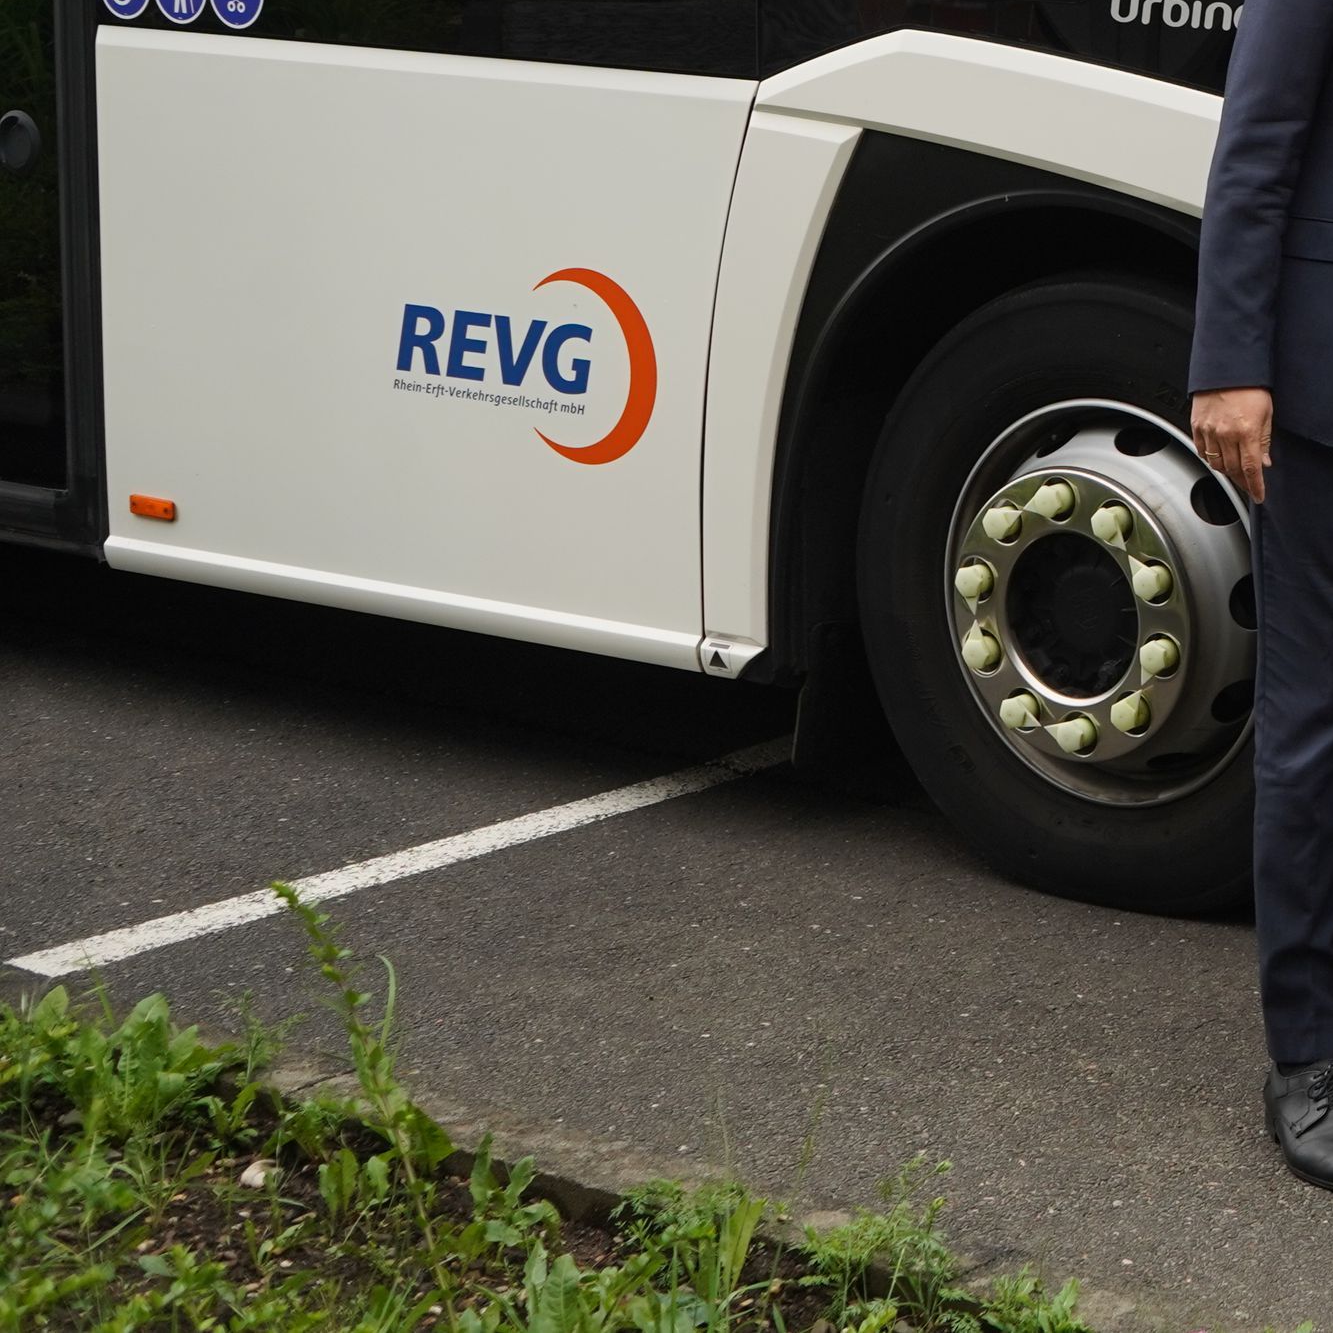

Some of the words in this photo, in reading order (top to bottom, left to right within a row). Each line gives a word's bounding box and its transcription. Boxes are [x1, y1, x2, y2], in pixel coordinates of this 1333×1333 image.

[396, 303, 593, 395] REVG
[393, 379, 558, 415] Rhein-Erft-Verkehrsgesellschaft
[560, 401, 585, 416] mbH
